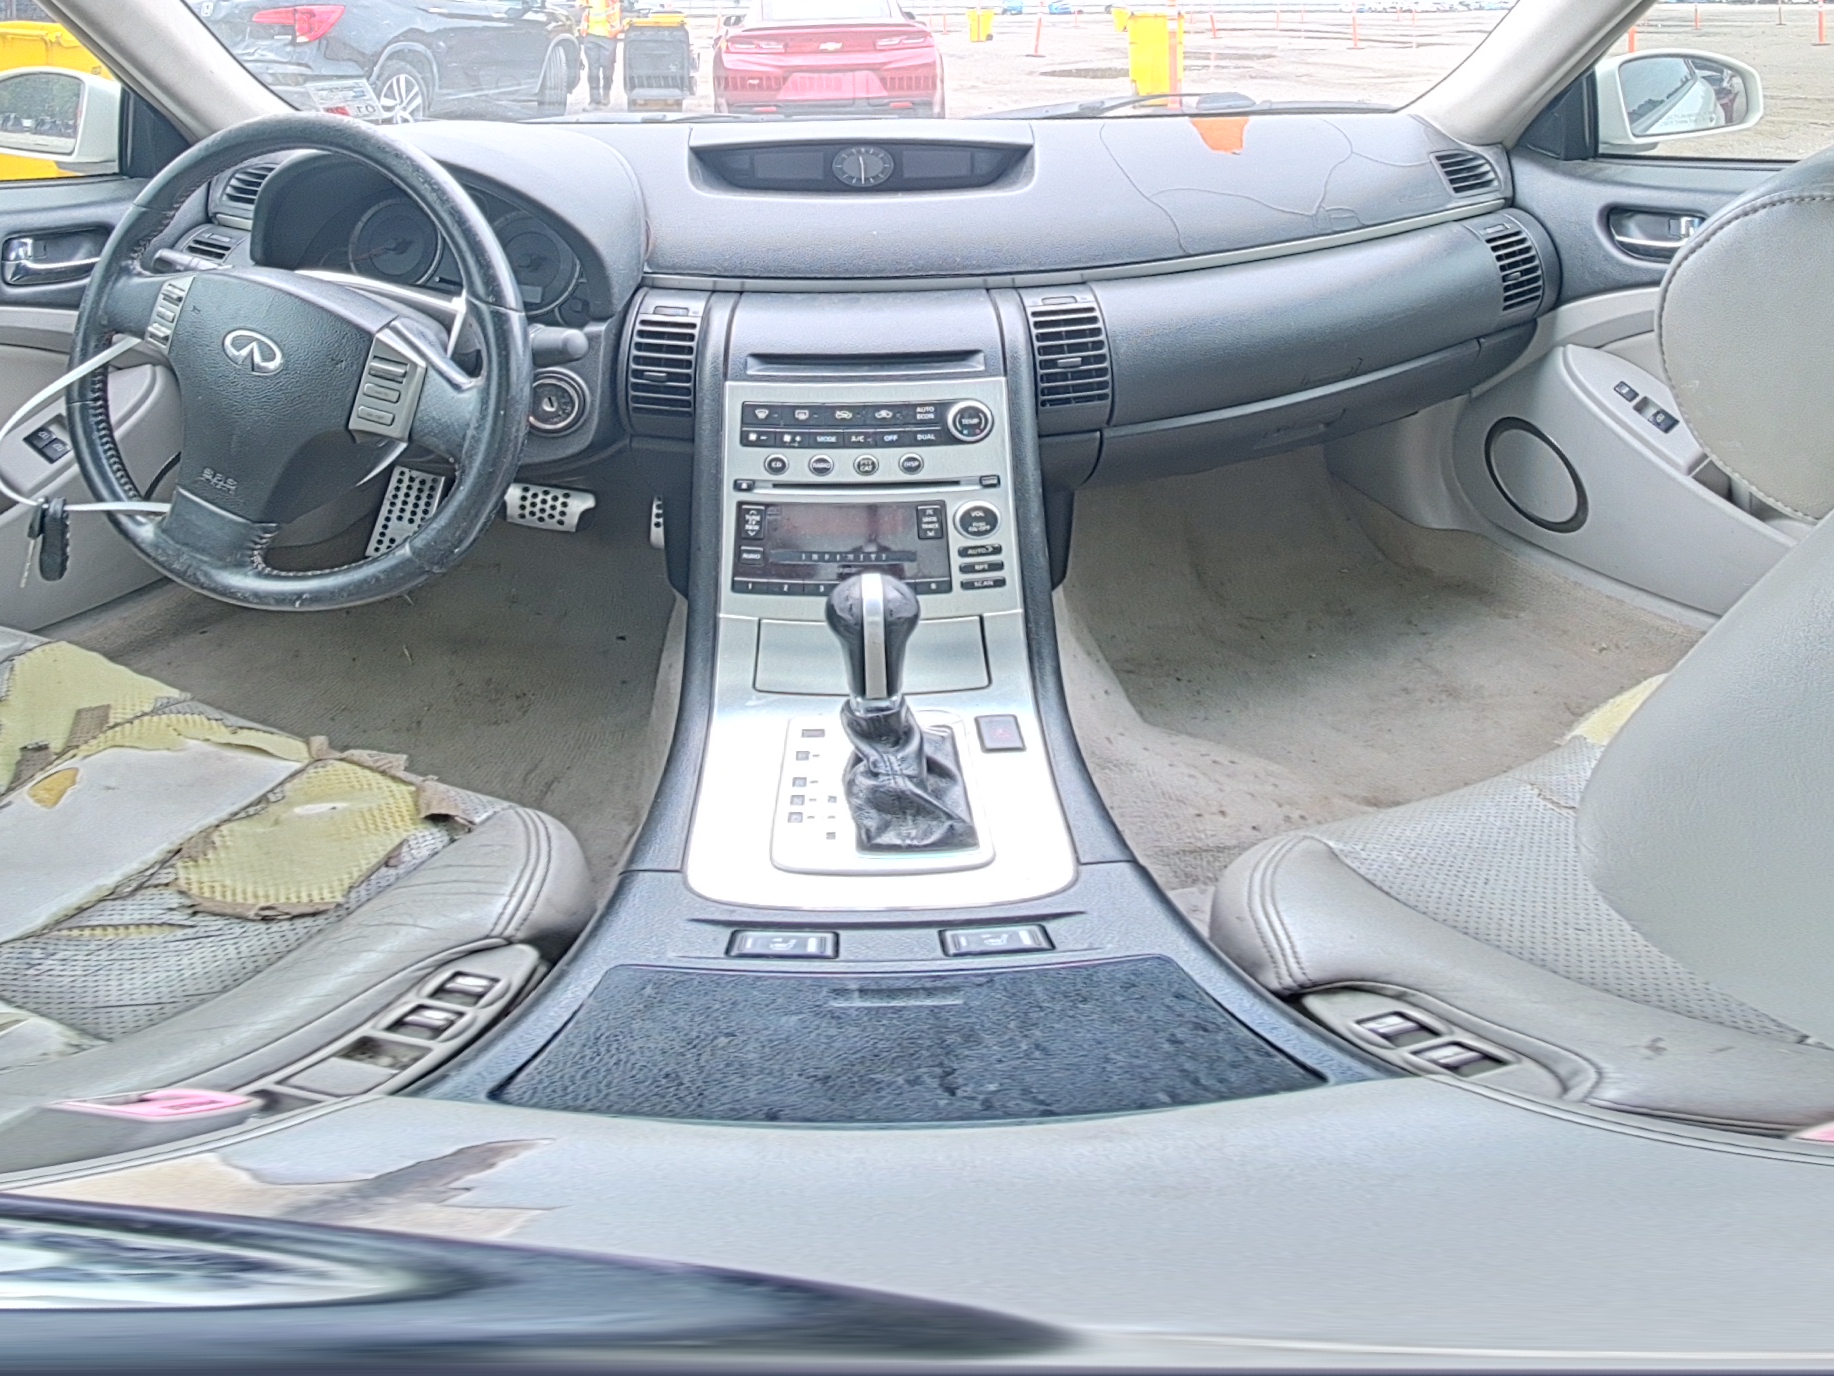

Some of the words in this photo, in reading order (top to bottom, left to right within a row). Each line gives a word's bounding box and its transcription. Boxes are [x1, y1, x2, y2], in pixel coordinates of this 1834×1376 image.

[816, 435, 837, 443] MODE
[851, 434, 865, 442] A/C
[883, 434, 899, 442] OFF
[969, 510, 985, 518] VOL
